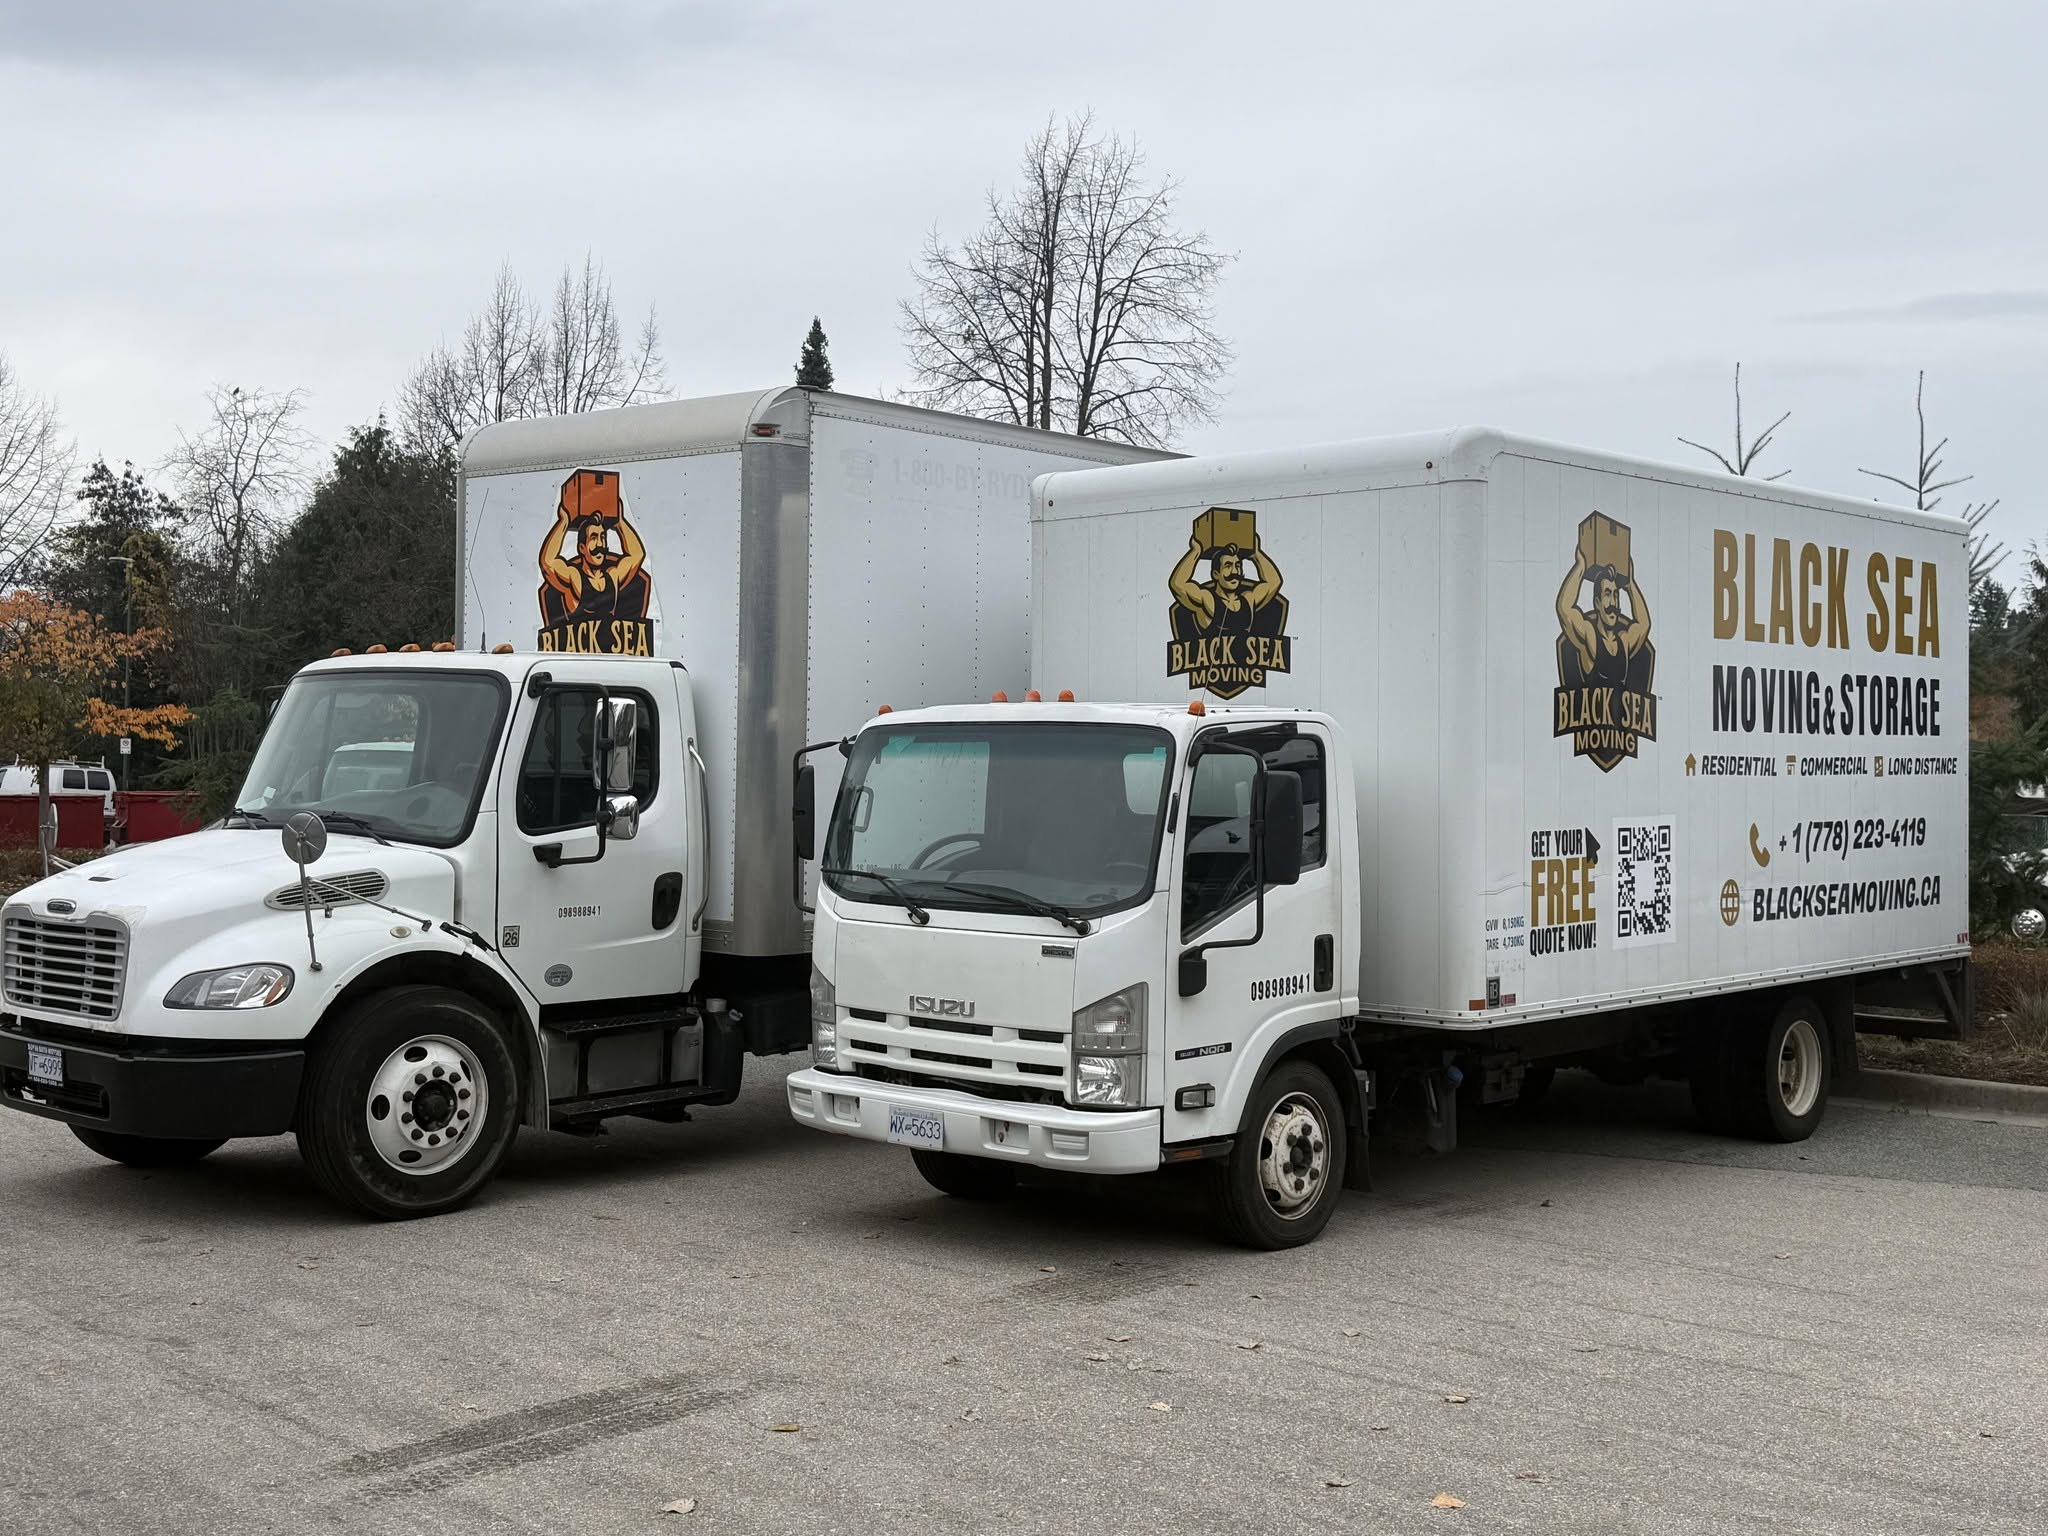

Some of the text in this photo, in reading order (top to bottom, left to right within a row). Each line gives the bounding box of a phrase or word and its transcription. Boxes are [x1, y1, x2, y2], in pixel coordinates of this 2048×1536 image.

[1714, 529, 1940, 658] BLACK SEA
[611, 620, 650, 656] SEA
[1172, 636, 1237, 673] BLACK
[1246, 636, 1286, 669] SEA
[1192, 667, 1264, 686] MOVING
[1558, 687, 1653, 736] BLACK SEA
[1576, 728, 1636, 753] MOVING
[1701, 755, 1777, 776] RESIDENTIAL
[1800, 757, 1868, 776] COMMERCIAL
[1888, 757, 1958, 776] LONG DISTANCE
[1531, 829, 1583, 857] GET YOUR
[1805, 820, 1849, 863] (778)
[1853, 817, 1926, 850] 223-4119
[1531, 857, 1596, 927] FREE
[1753, 876, 1940, 922] BLACKSEAMOVING.CA
[558, 906, 601, 918] 098988941
[1485, 919, 1498, 931] GVW
[504, 931, 518, 946] 26
[1486, 938, 1499, 951] TARE
[1530, 923, 1597, 957] QUOTE NOW!
[1251, 973, 1310, 1001] 098988941
[909, 994, 975, 1018] ISUZU
[1199, 1044, 1226, 1057] NQR
